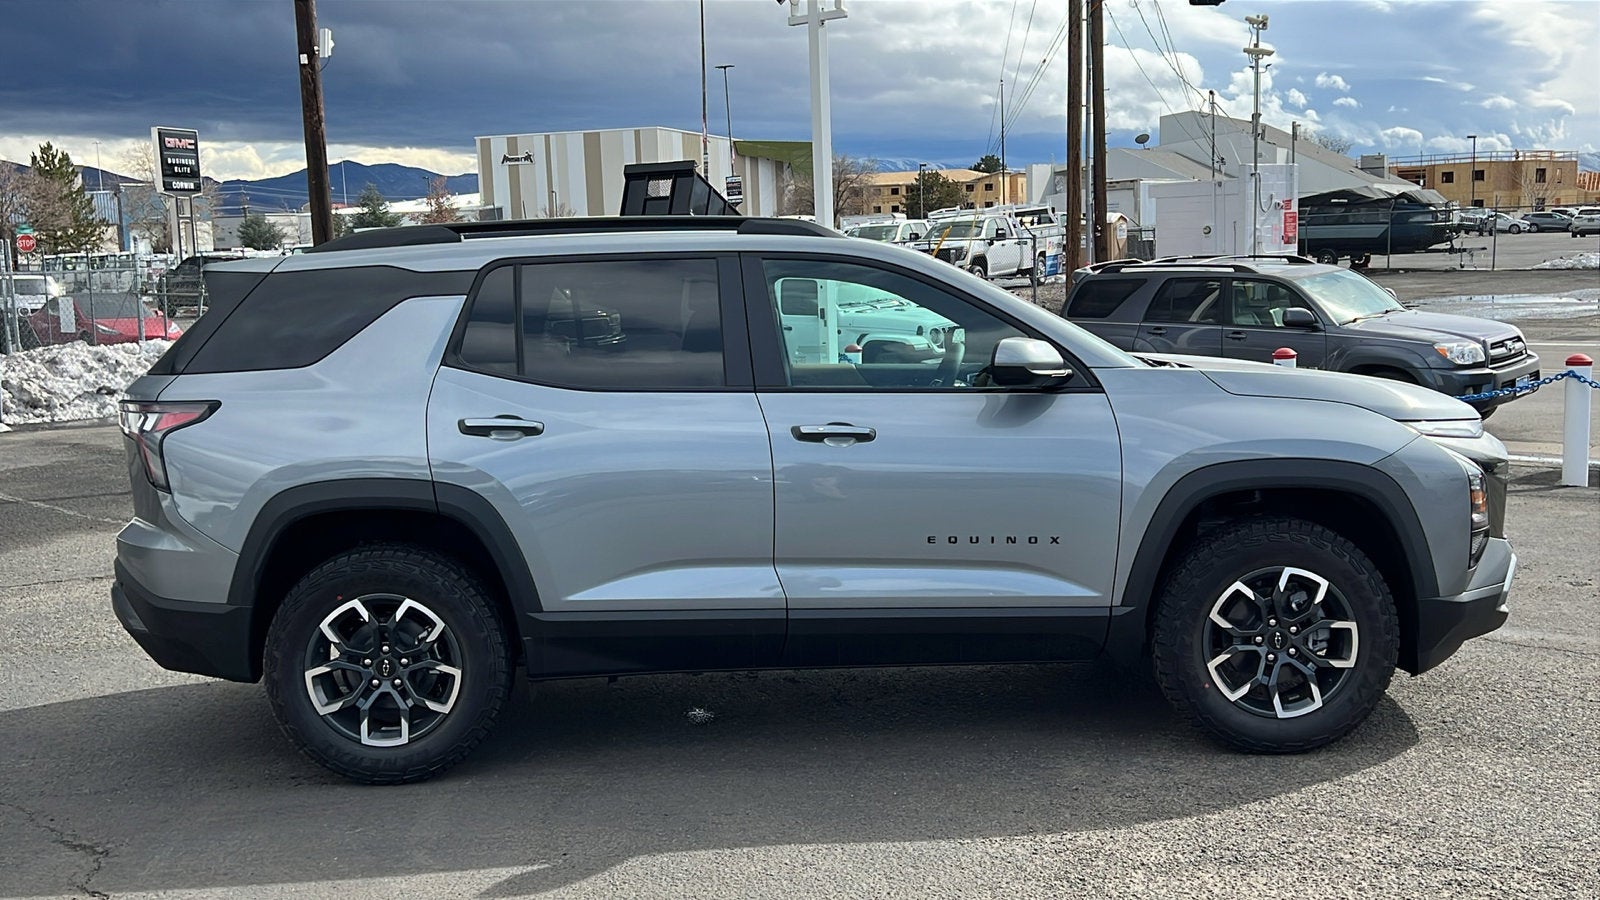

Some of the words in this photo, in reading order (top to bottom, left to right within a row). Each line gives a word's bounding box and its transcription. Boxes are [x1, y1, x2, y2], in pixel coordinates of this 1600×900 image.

[164, 137, 195, 149] GMC
[167, 157, 196, 166] BUSINESS
[174, 166, 191, 174] ELITE
[172, 181, 195, 190] CORWIN
[18, 239, 35, 248] STOP
[926, 535, 1061, 545] EQUINOX
